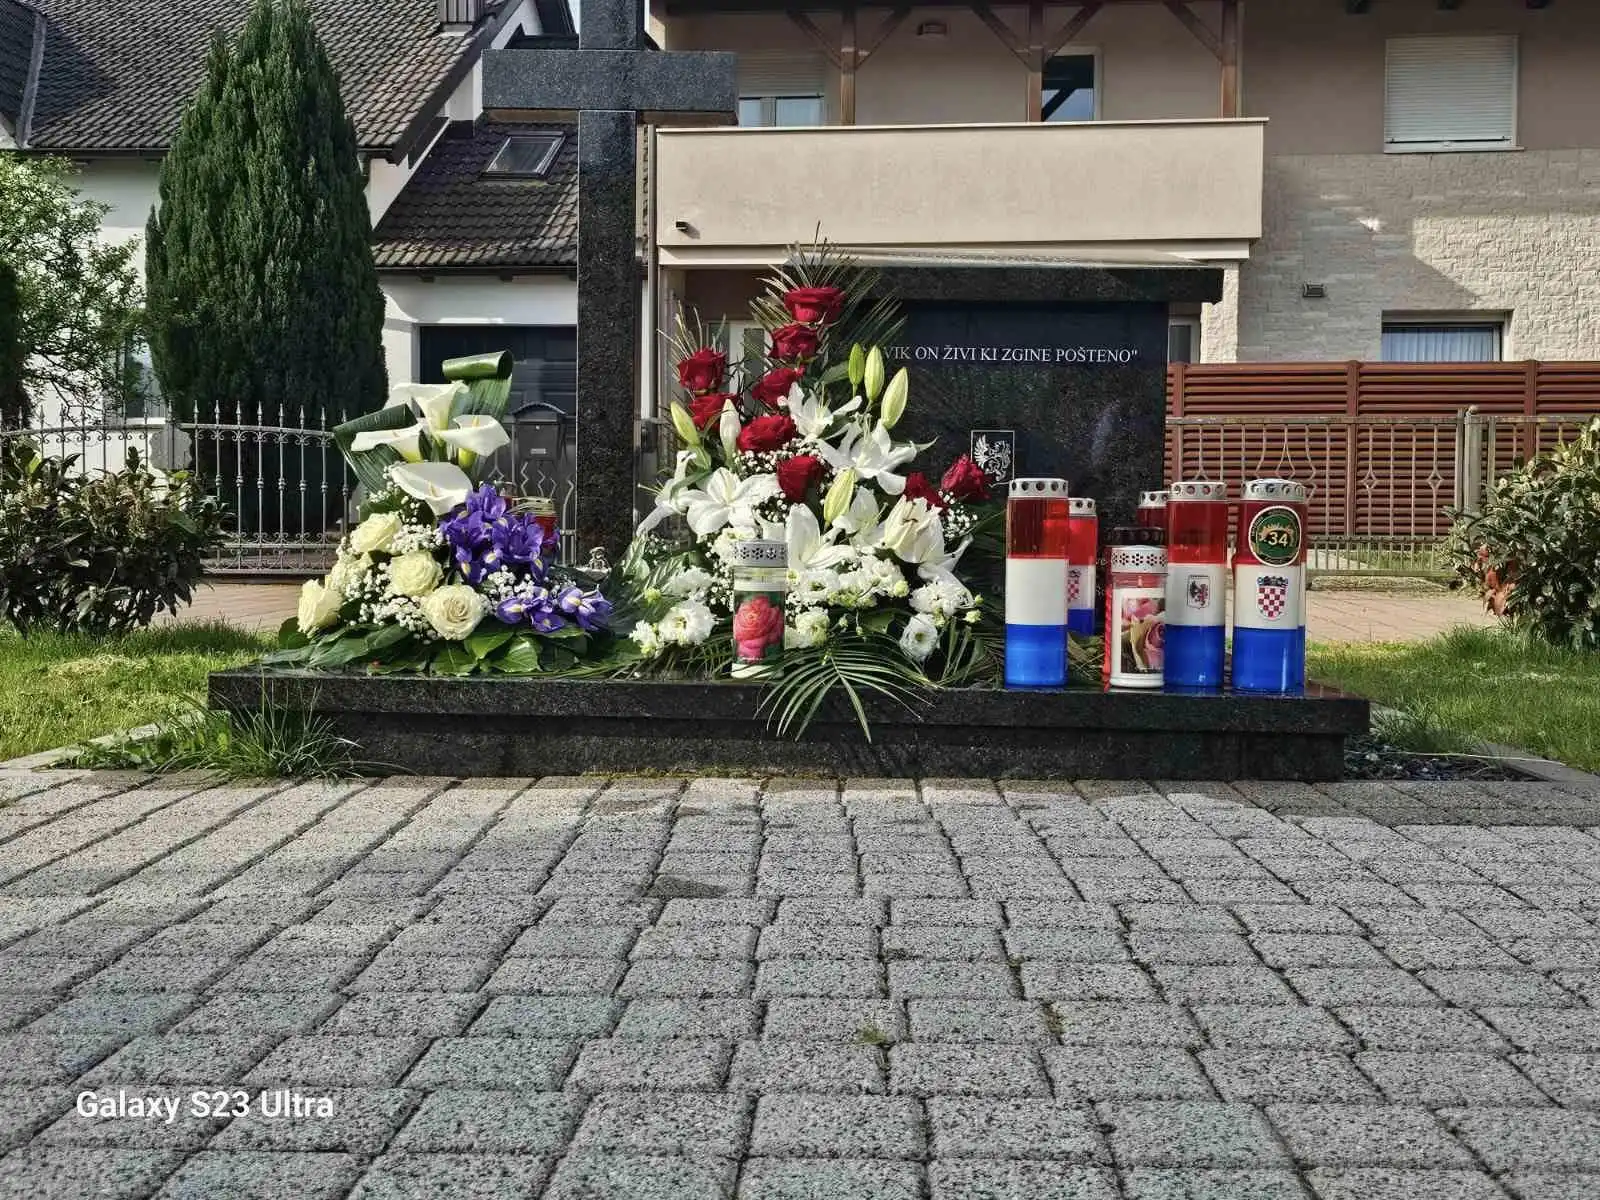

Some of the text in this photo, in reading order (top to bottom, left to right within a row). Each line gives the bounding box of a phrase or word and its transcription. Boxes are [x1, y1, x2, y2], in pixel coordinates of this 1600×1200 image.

[915, 346, 939, 360] ON
[943, 344, 976, 361] ŽIVI
[980, 347, 997, 361] KI
[1001, 347, 1051, 362] ZGINE
[1055, 346, 1138, 363] POŠTENO"
[1268, 531, 1288, 547] 34
